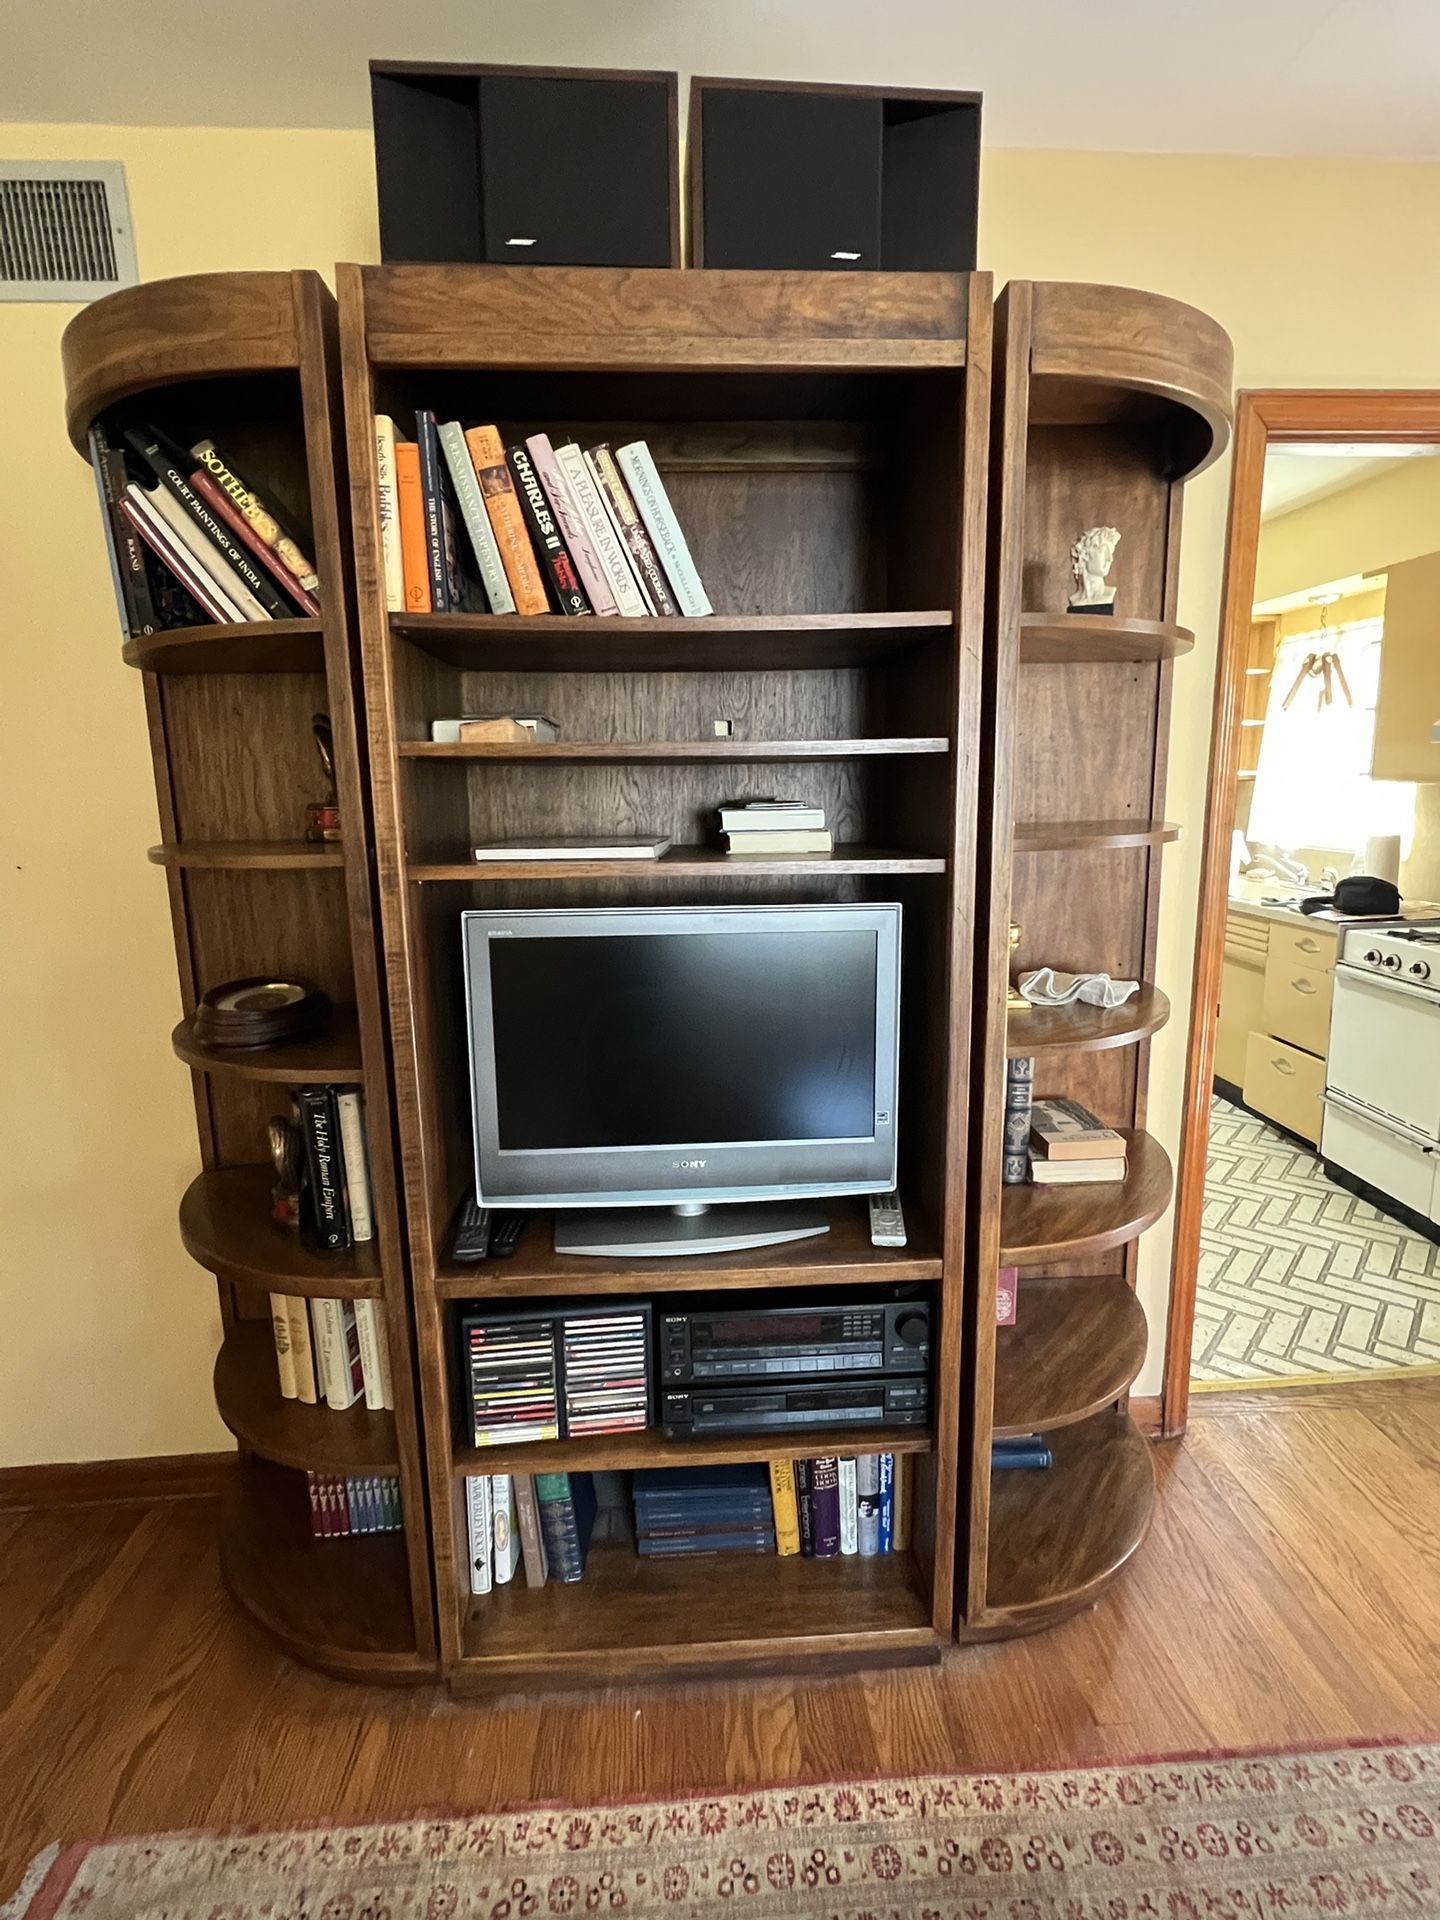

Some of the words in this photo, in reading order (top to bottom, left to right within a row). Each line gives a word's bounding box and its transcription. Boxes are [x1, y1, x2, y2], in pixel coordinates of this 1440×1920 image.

[375, 435, 386, 462] Beverly
[443, 428, 456, 441] A
[378, 463, 388, 480] Sills
[446, 441, 482, 521] RENAISSANCE
[568, 466, 583, 480] A
[628, 454, 653, 497] MORNINGS
[377, 483, 394, 532] Bubbles
[427, 497, 436, 512] THE
[509, 448, 557, 536] CHARLES
[544, 534, 562, 551] II
[572, 477, 610, 538] PLEASURE
[644, 493, 658, 509] ON
[165, 467, 195, 502] COURT
[188, 497, 231, 550] PAINTINGS
[226, 546, 242, 563] OF
[236, 559, 263, 590] INDIA
[428, 513, 438, 536] STORY
[648, 505, 677, 555] HORSEBACK
[430, 537, 439, 547] OF
[472, 525, 501, 584] TAPESTRY
[597, 534, 614, 551] IN
[431, 549, 442, 581] ENGLISH
[601, 547, 633, 594] WORDS
[645, 566, 668, 603] COURAGE
[312, 1111, 328, 1130] The
[310, 1128, 331, 1154] Holy
[317, 1152, 334, 1186] Roman
[671, 1159, 707, 1168] SONY
[317, 1185, 339, 1221] Empire
[473, 1530, 485, 1556] ROOT
